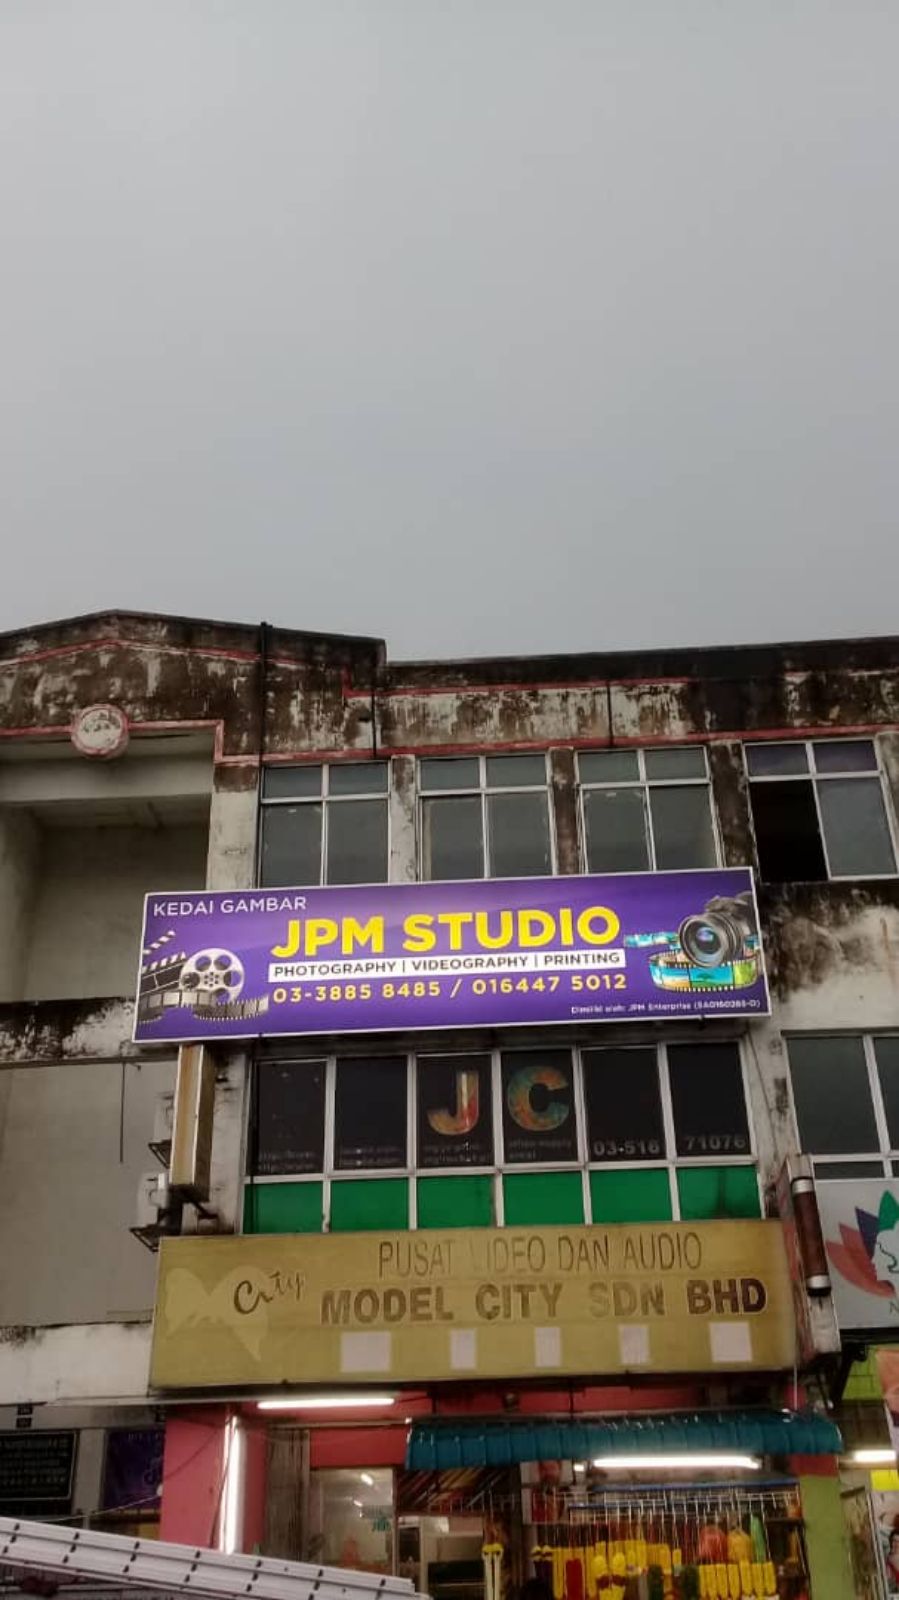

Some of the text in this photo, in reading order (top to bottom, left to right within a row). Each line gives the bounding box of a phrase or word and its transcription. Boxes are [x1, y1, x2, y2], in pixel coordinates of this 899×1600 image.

[153, 896, 307, 917] KEDAI GAMBAR
[269, 906, 621, 958] JPM STUDIO
[273, 959, 397, 977] PHOTOGRAPHY
[411, 955, 528, 972] VIDEOGRAPHY
[544, 951, 621, 967] PRINTING
[272, 984, 372, 1003] 03-3885
[382, 981, 441, 999] 8485
[471, 976, 559, 996] 016447
[571, 973, 627, 992] 5012
[377, 1239, 456, 1280] PUSAT
[557, 1233, 609, 1273] DAN
[623, 1231, 703, 1271] AUDIO
[320, 1277, 768, 1326] MODEL CITY SDN BHD
